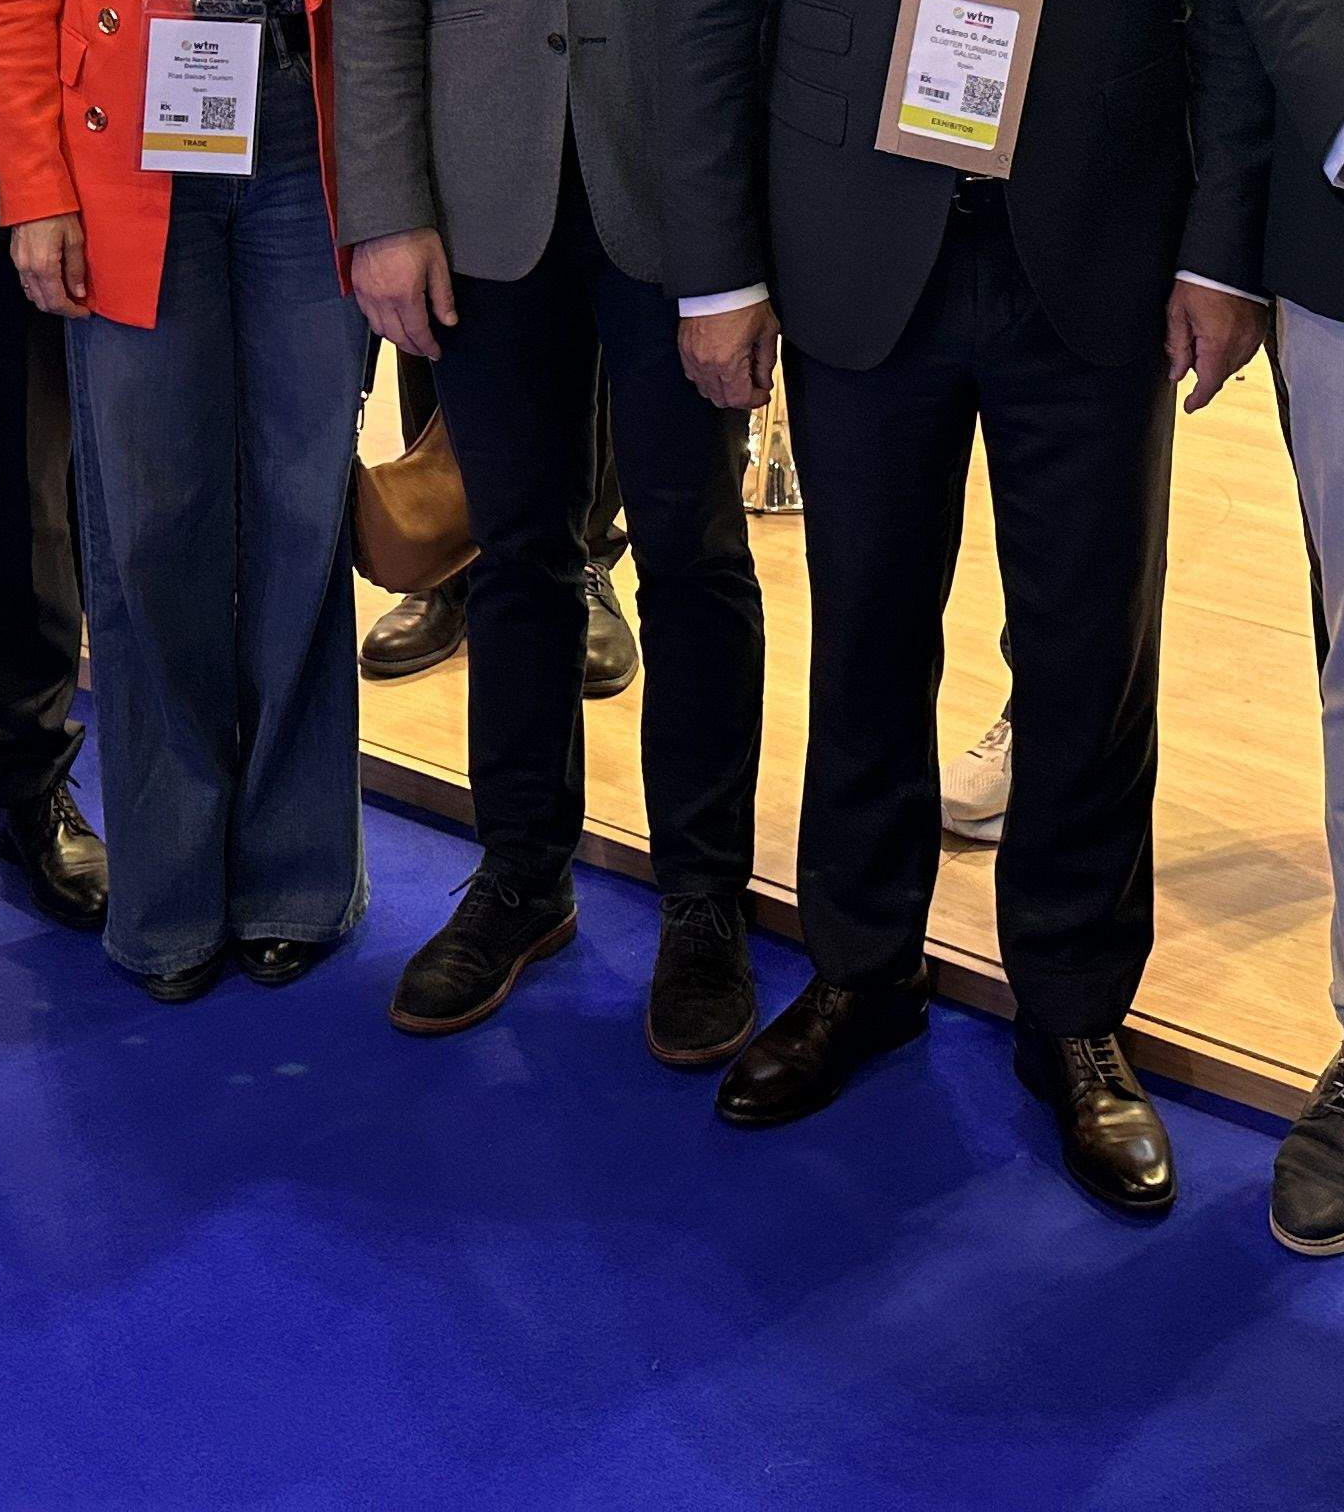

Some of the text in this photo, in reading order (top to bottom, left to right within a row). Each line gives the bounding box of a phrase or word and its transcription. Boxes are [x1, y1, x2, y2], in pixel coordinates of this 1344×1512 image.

[966, 11, 994, 25] wtm
[193, 41, 219, 51] wtm
[931, 117, 974, 134] EXHIBITOR
